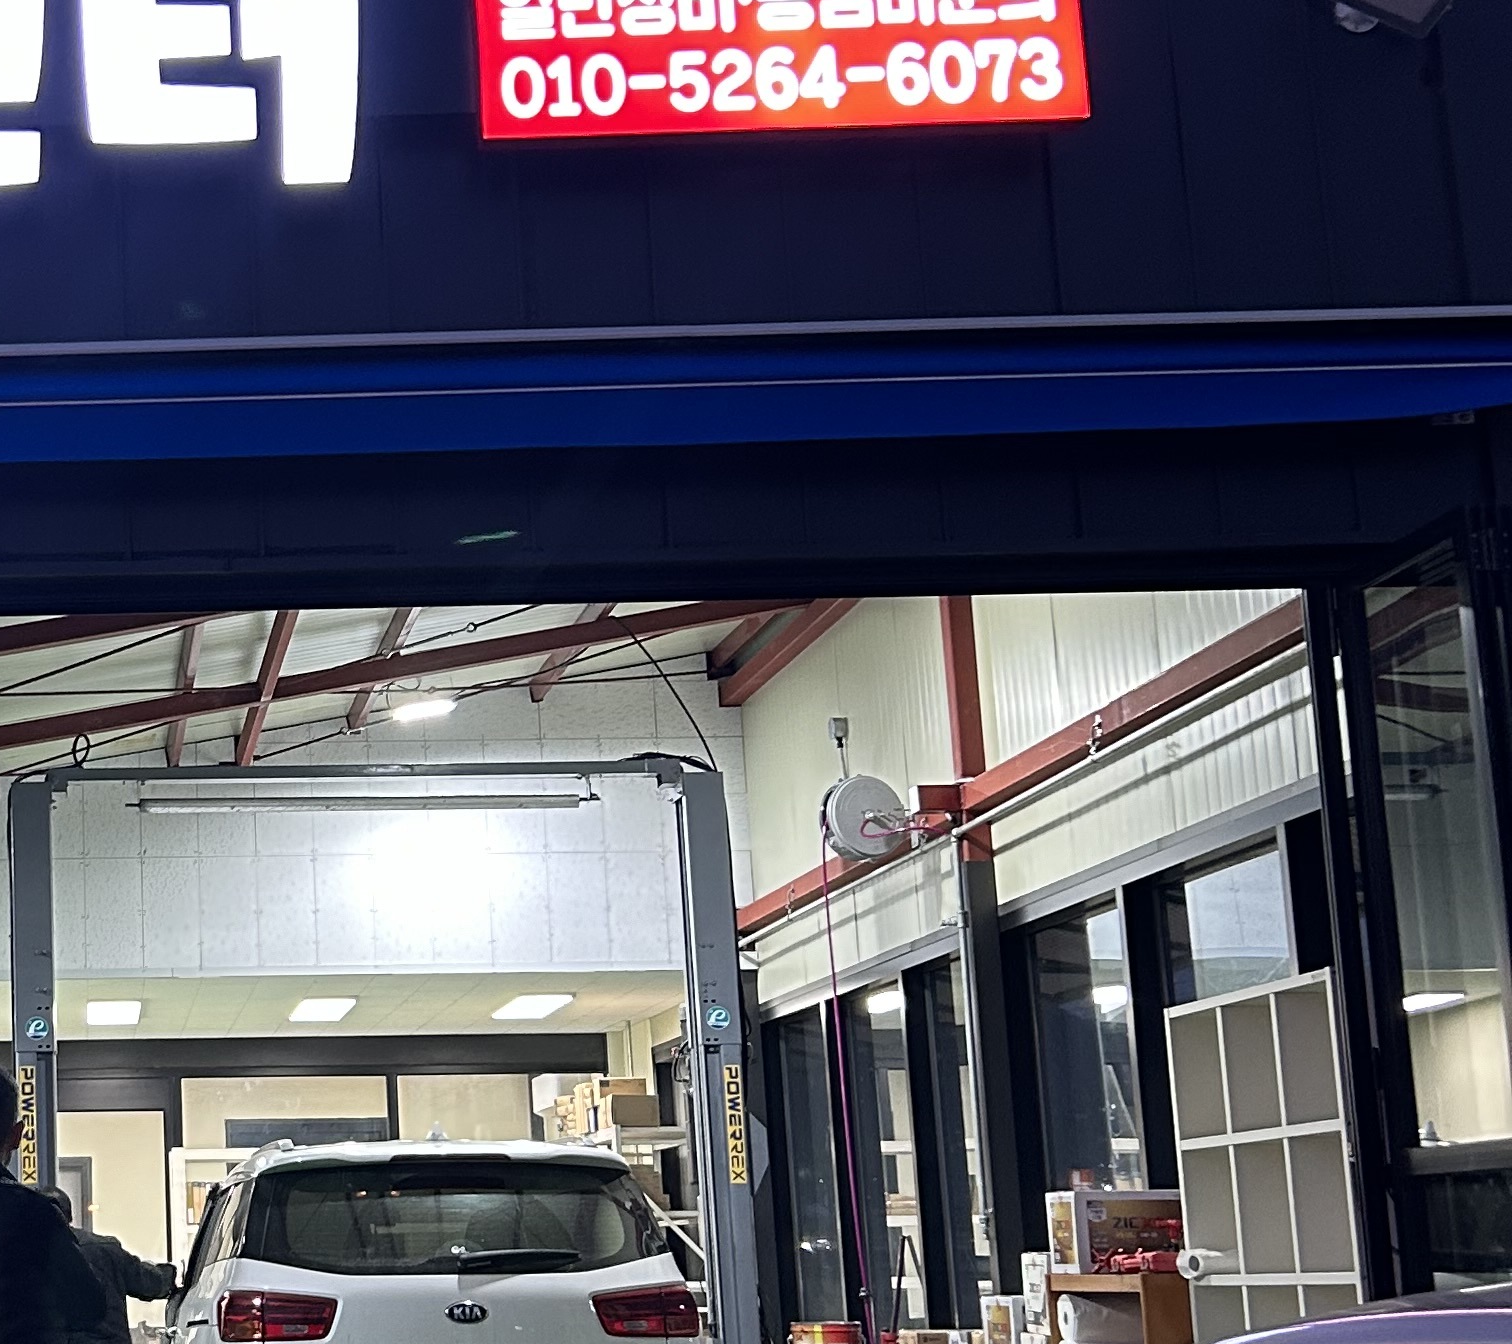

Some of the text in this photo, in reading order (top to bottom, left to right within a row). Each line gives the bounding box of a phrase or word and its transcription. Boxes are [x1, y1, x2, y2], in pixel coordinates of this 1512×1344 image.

[501, 37, 1064, 119] 010-5264-6073
[725, 1066, 747, 1182] POWERREX
[452, 1306, 485, 1321] KIA
